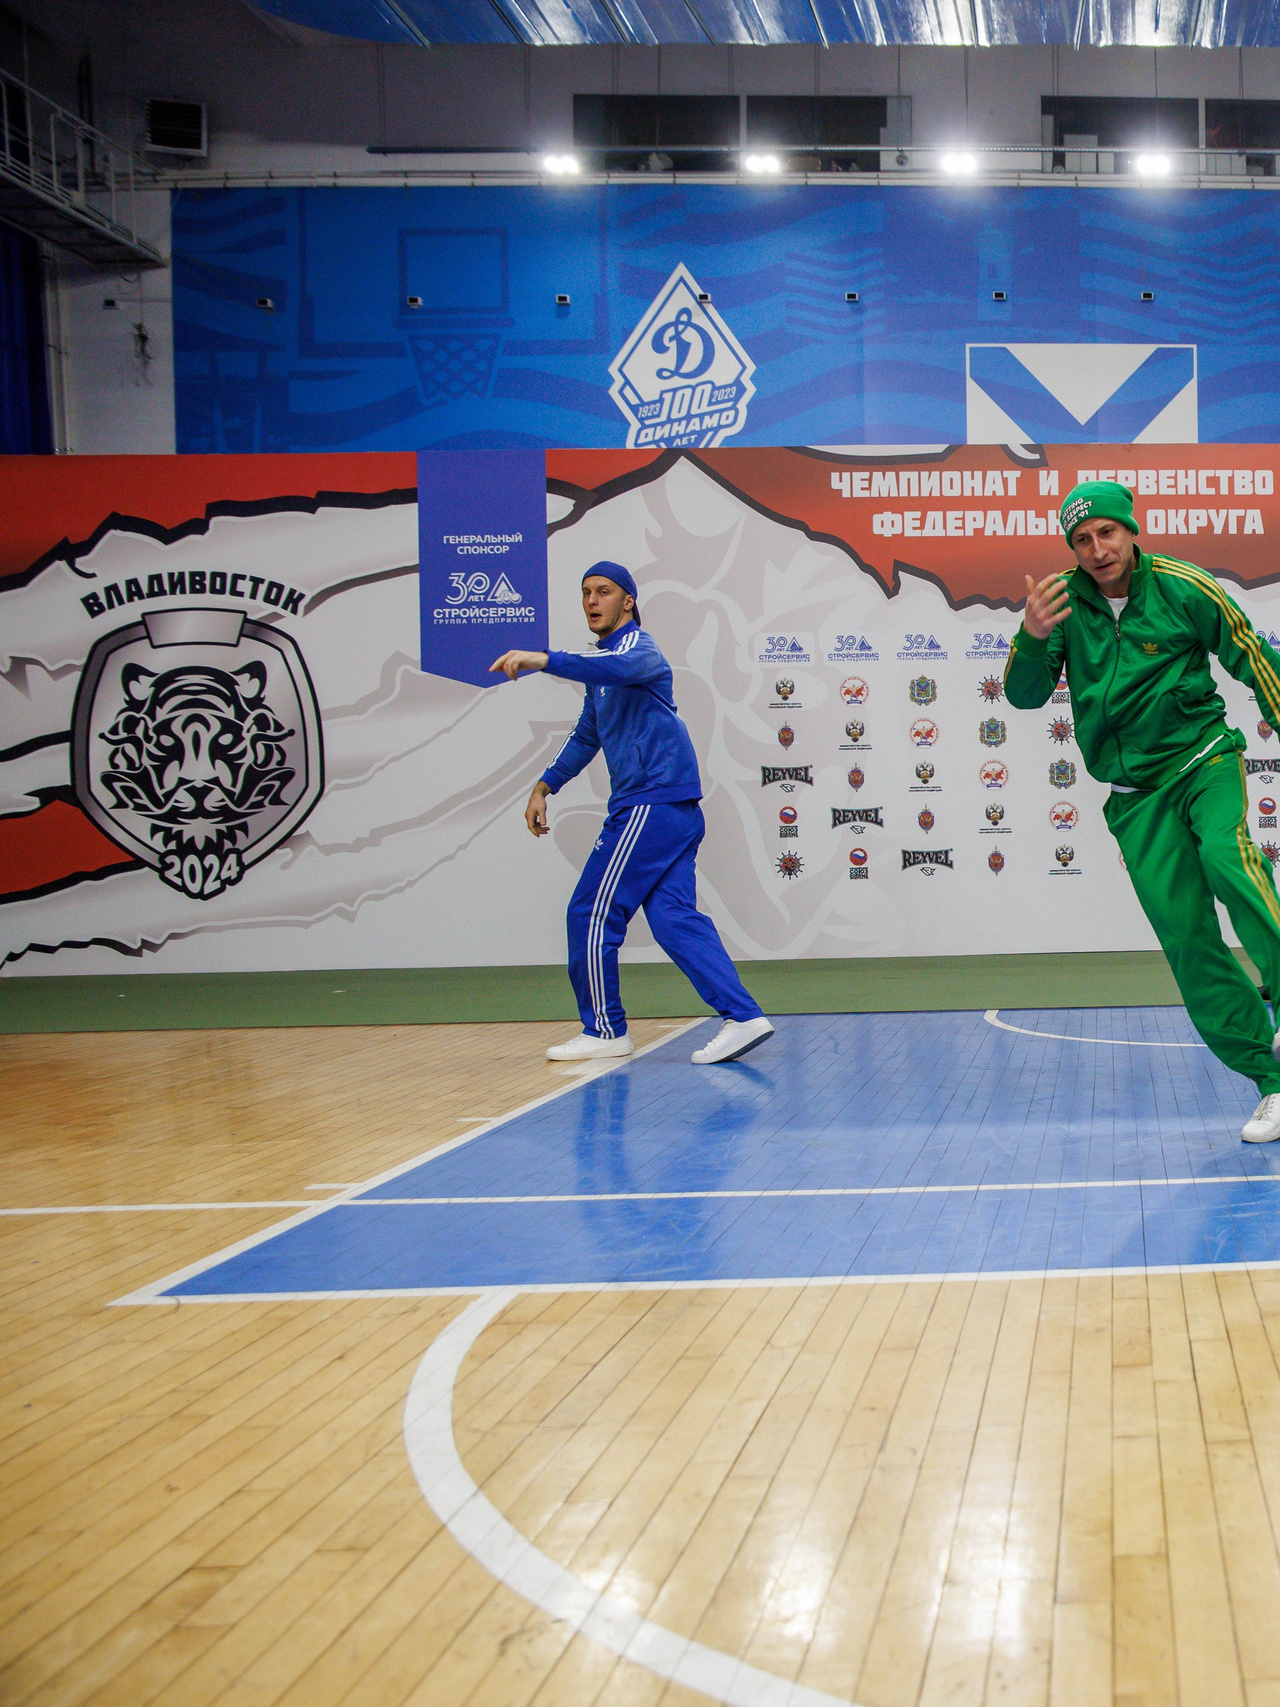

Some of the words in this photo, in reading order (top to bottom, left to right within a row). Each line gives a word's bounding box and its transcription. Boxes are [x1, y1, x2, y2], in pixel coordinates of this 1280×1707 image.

[638, 403, 660, 419] 1923
[657, 382, 713, 422] 100
[712, 386, 736, 402] 2023
[637, 409, 735, 443] ДИНАМО
[673, 435, 697, 447] ЛЕТ
[831, 470, 1021, 498] ЧЕМПИОНАТ
[1039, 470, 1059, 496] И
[872, 510, 1065, 537] ФЕДЕРАЛЬН
[1146, 509, 1264, 534] ОКРУГА
[443, 532, 523, 544] ГЕНЕРАЛЬНЫЙ
[457, 545, 510, 555] СПОНСОР
[80, 571, 306, 618] ВЛАДИВОСТОК
[433, 606, 535, 618] СТРОЙСЕРВИС
[761, 765, 813, 787] REYVEL
[831, 807, 883, 829] REYVEL
[901, 849, 953, 871] REYVEL
[163, 853, 240, 894] 2024
